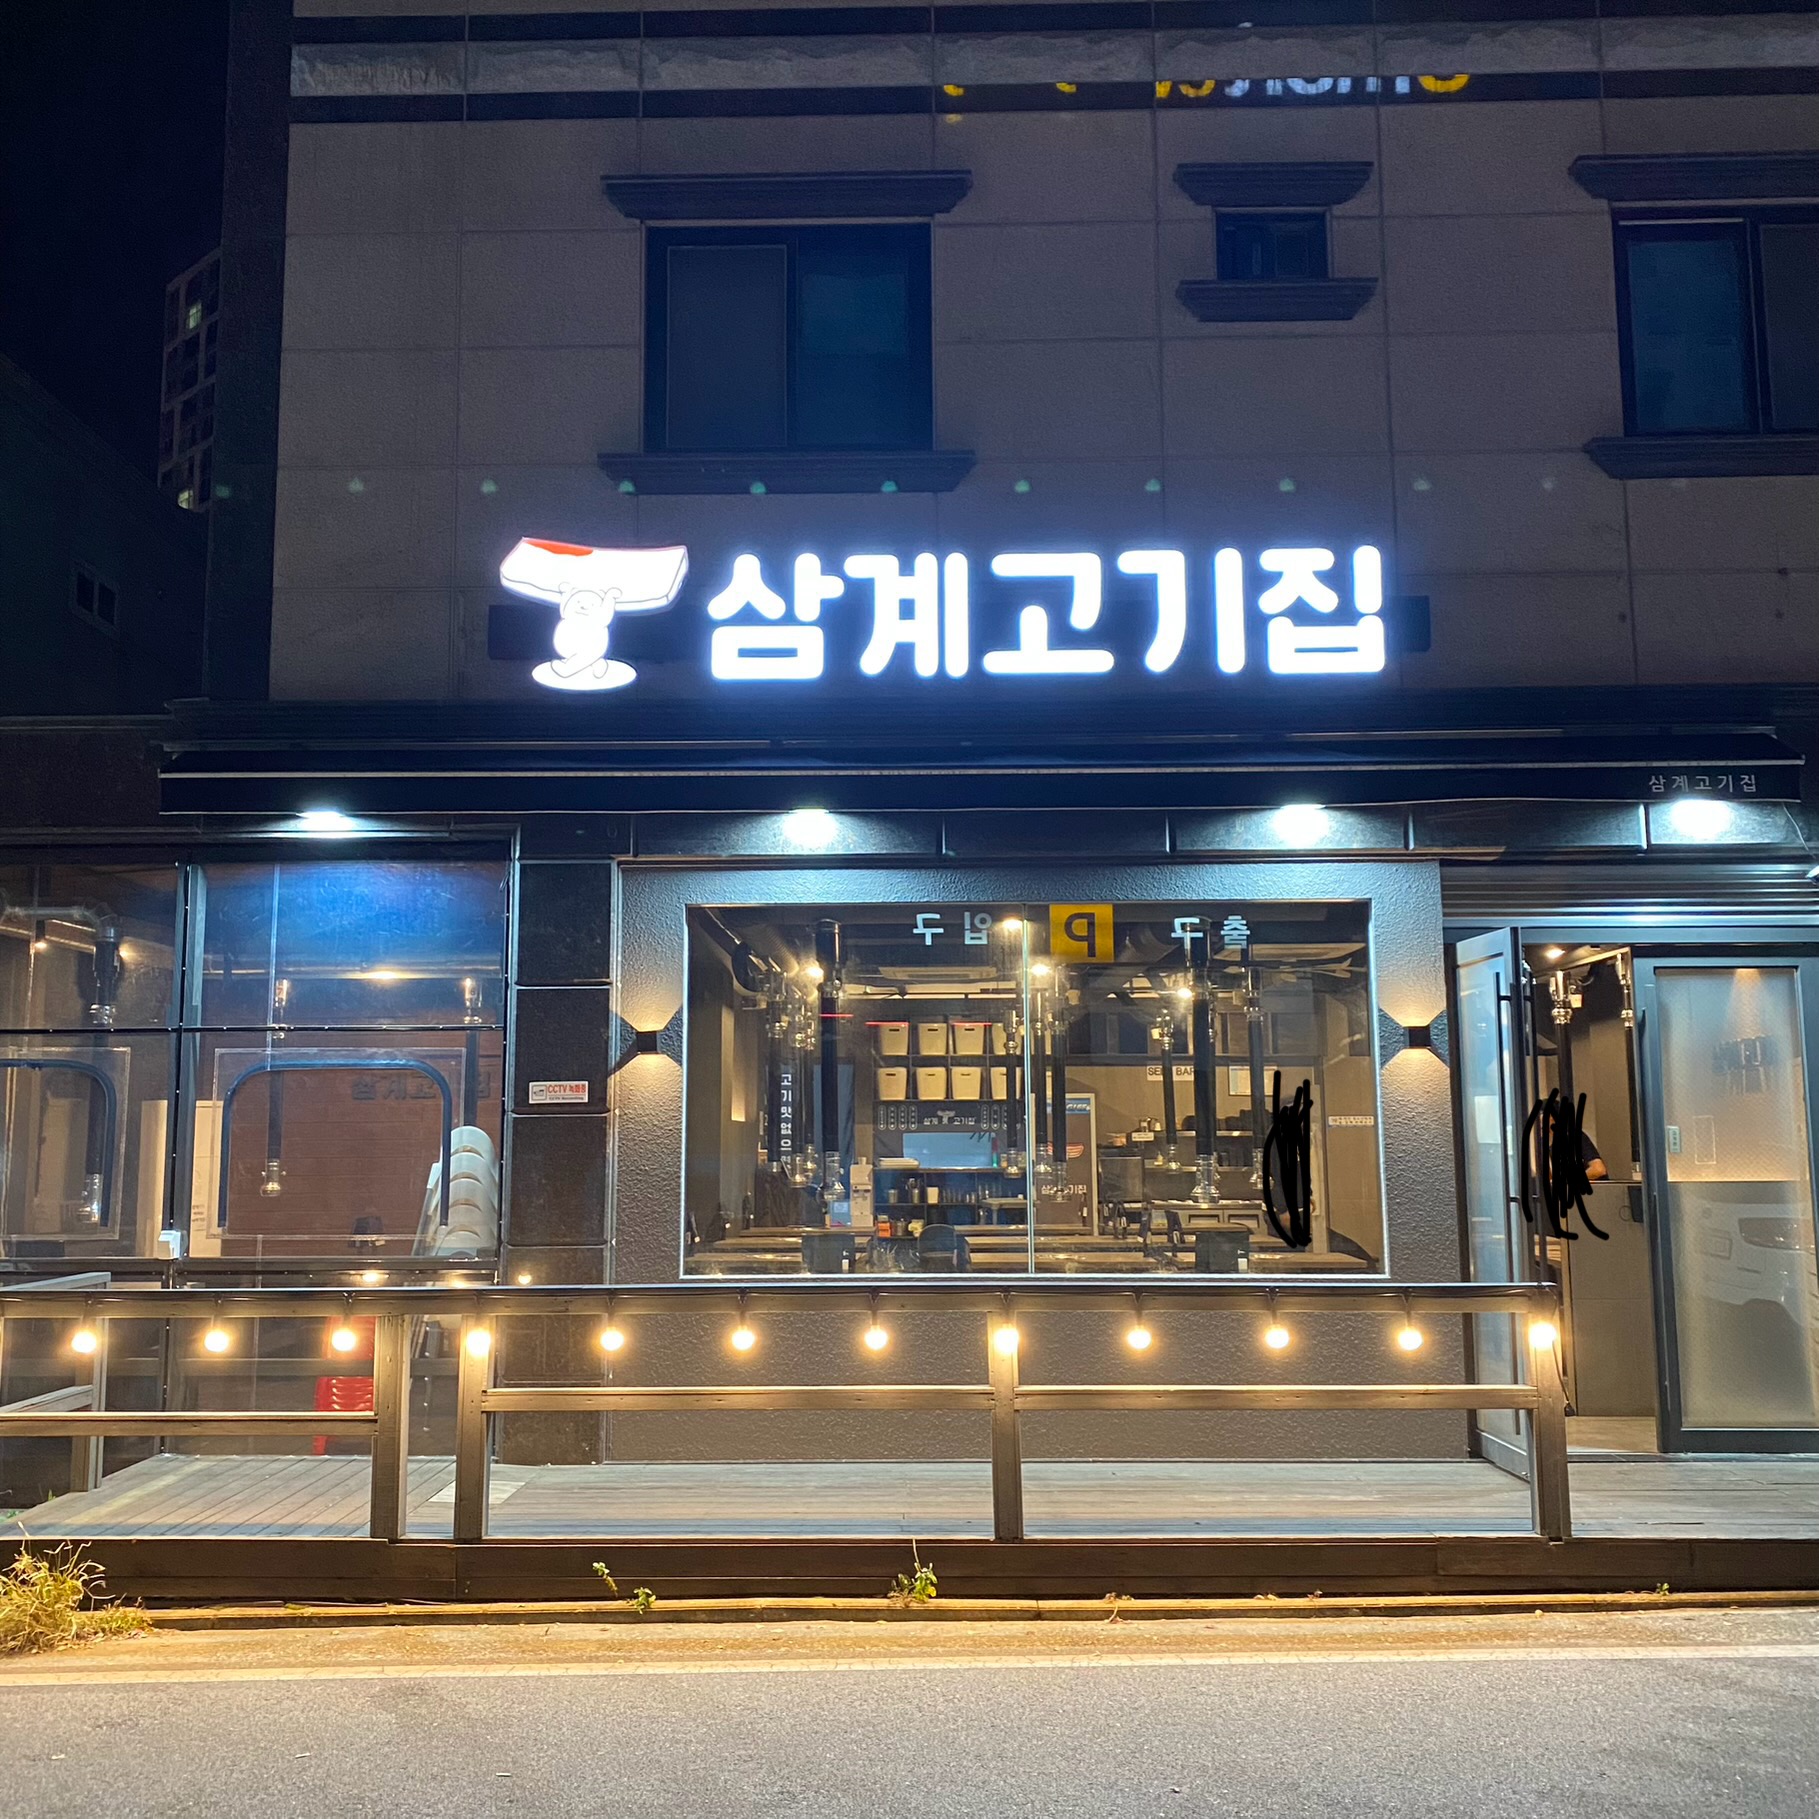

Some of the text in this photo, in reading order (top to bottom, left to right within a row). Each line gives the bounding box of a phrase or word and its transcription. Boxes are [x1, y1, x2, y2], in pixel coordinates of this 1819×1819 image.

[706, 544, 1387, 683] 삼계고기집
[1648, 774, 1757, 793] 삼계고기집
[547, 1083, 568, 1094] CCTV
